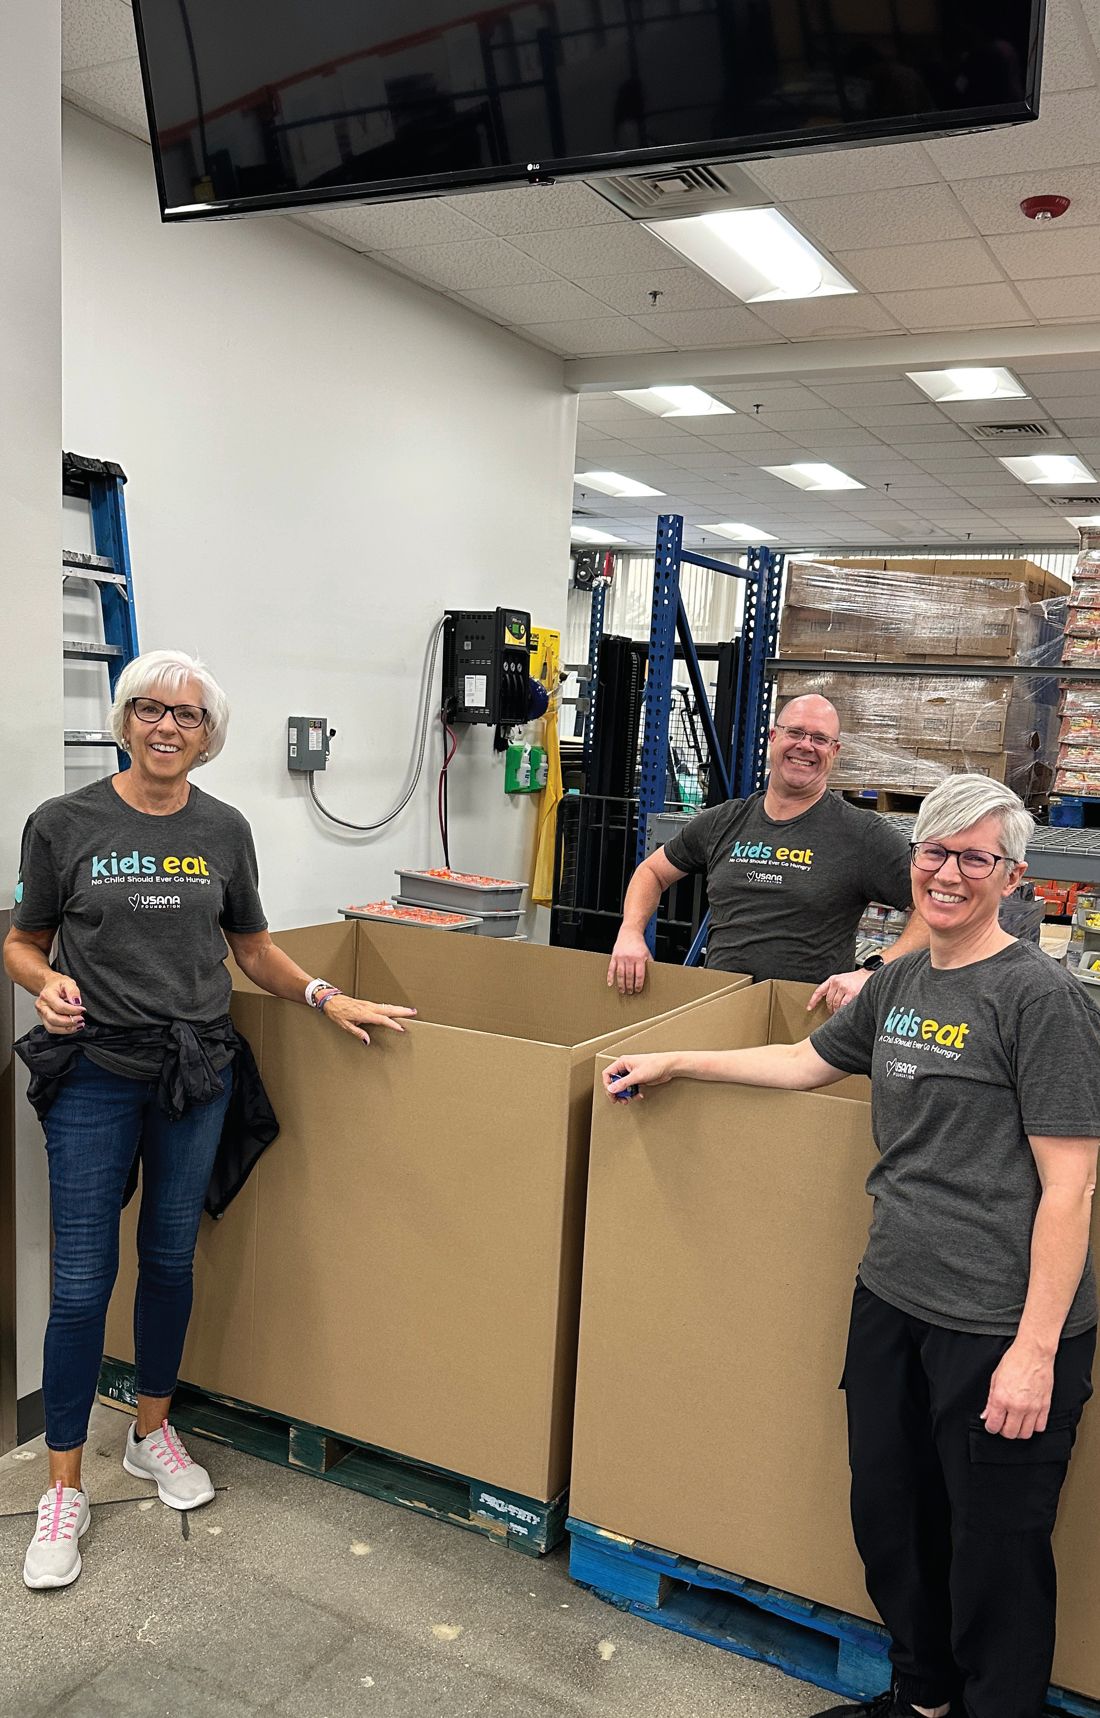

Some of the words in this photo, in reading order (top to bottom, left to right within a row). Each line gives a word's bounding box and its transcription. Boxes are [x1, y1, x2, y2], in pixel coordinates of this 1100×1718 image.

[731, 841, 773, 859] kids
[776, 847, 814, 865] eat
[92, 850, 157, 877] kids
[162, 856, 209, 876] eat
[790, 862, 812, 872] Hungry
[104, 876, 125, 884] Child
[187, 876, 211, 885] Hungry
[755, 872, 783, 881] USANA
[141, 895, 181, 905] USANA
[883, 1006, 922, 1038] kids
[921, 1019, 970, 1049] eat
[893, 1037, 913, 1048] Should
[930, 1044, 962, 1061] Hungry
